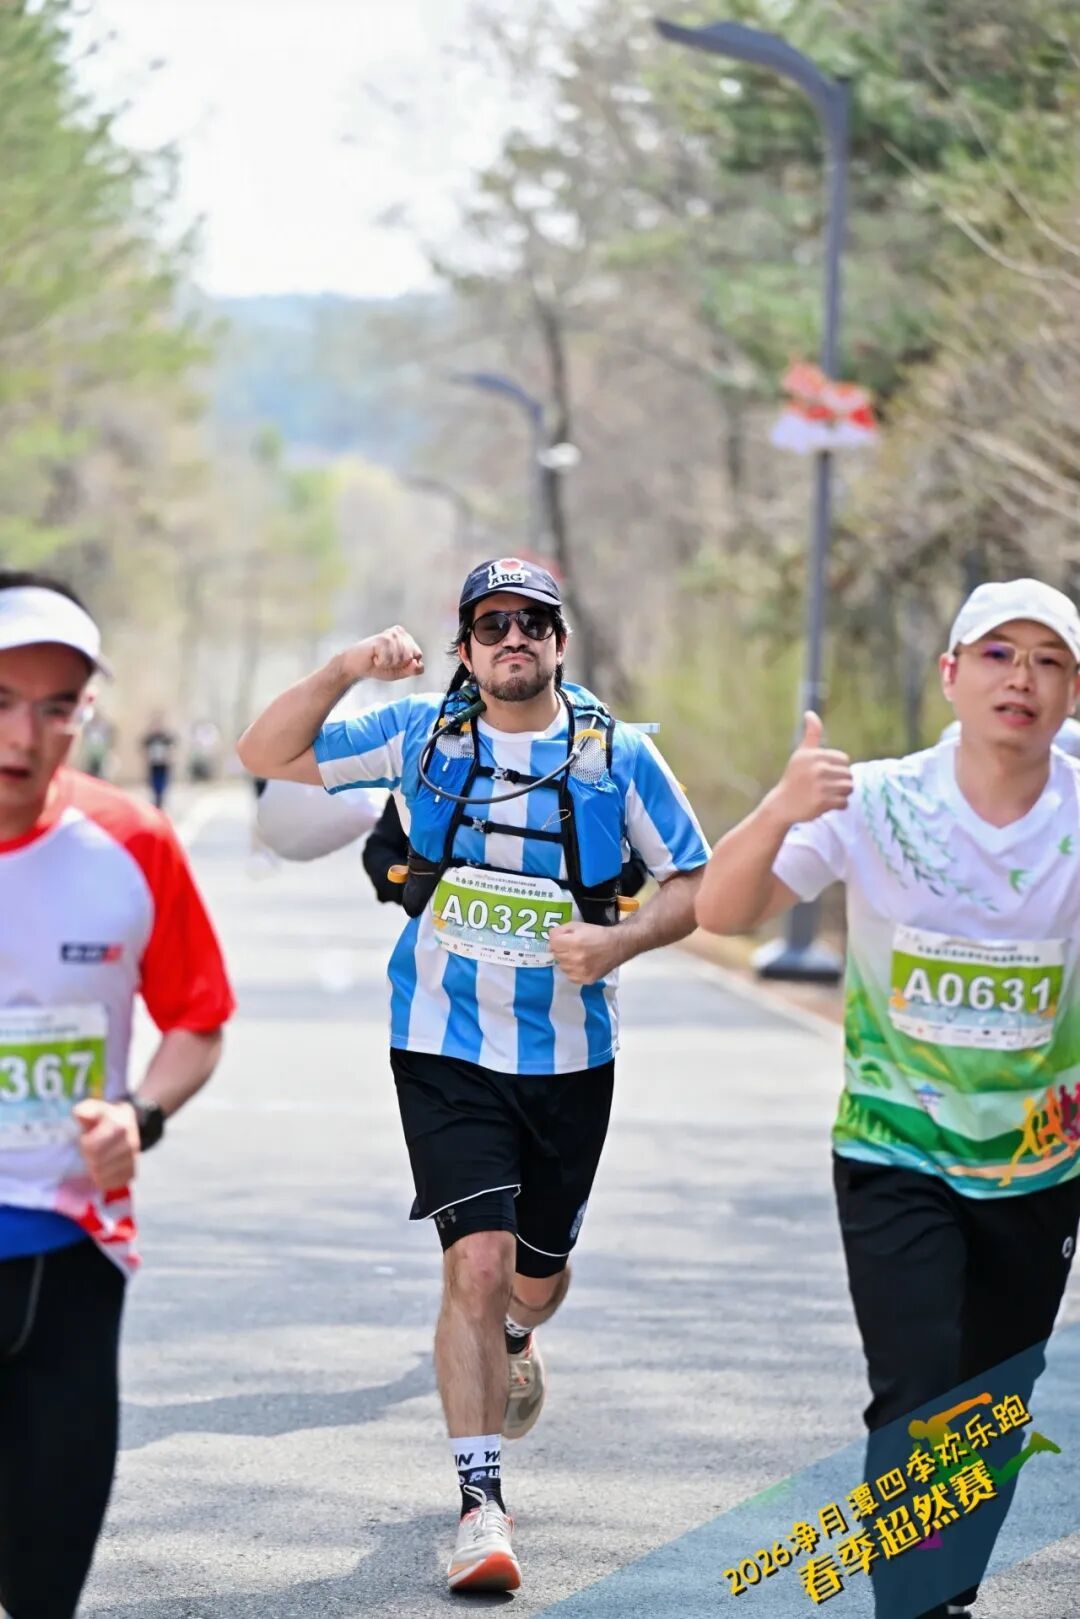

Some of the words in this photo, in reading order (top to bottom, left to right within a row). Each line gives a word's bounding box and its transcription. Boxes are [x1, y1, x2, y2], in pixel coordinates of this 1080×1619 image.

[491, 565, 497, 576] I
[491, 574, 522, 585] ARG
[440, 894, 563, 941] A0325
[903, 967, 1051, 1012] A0631
